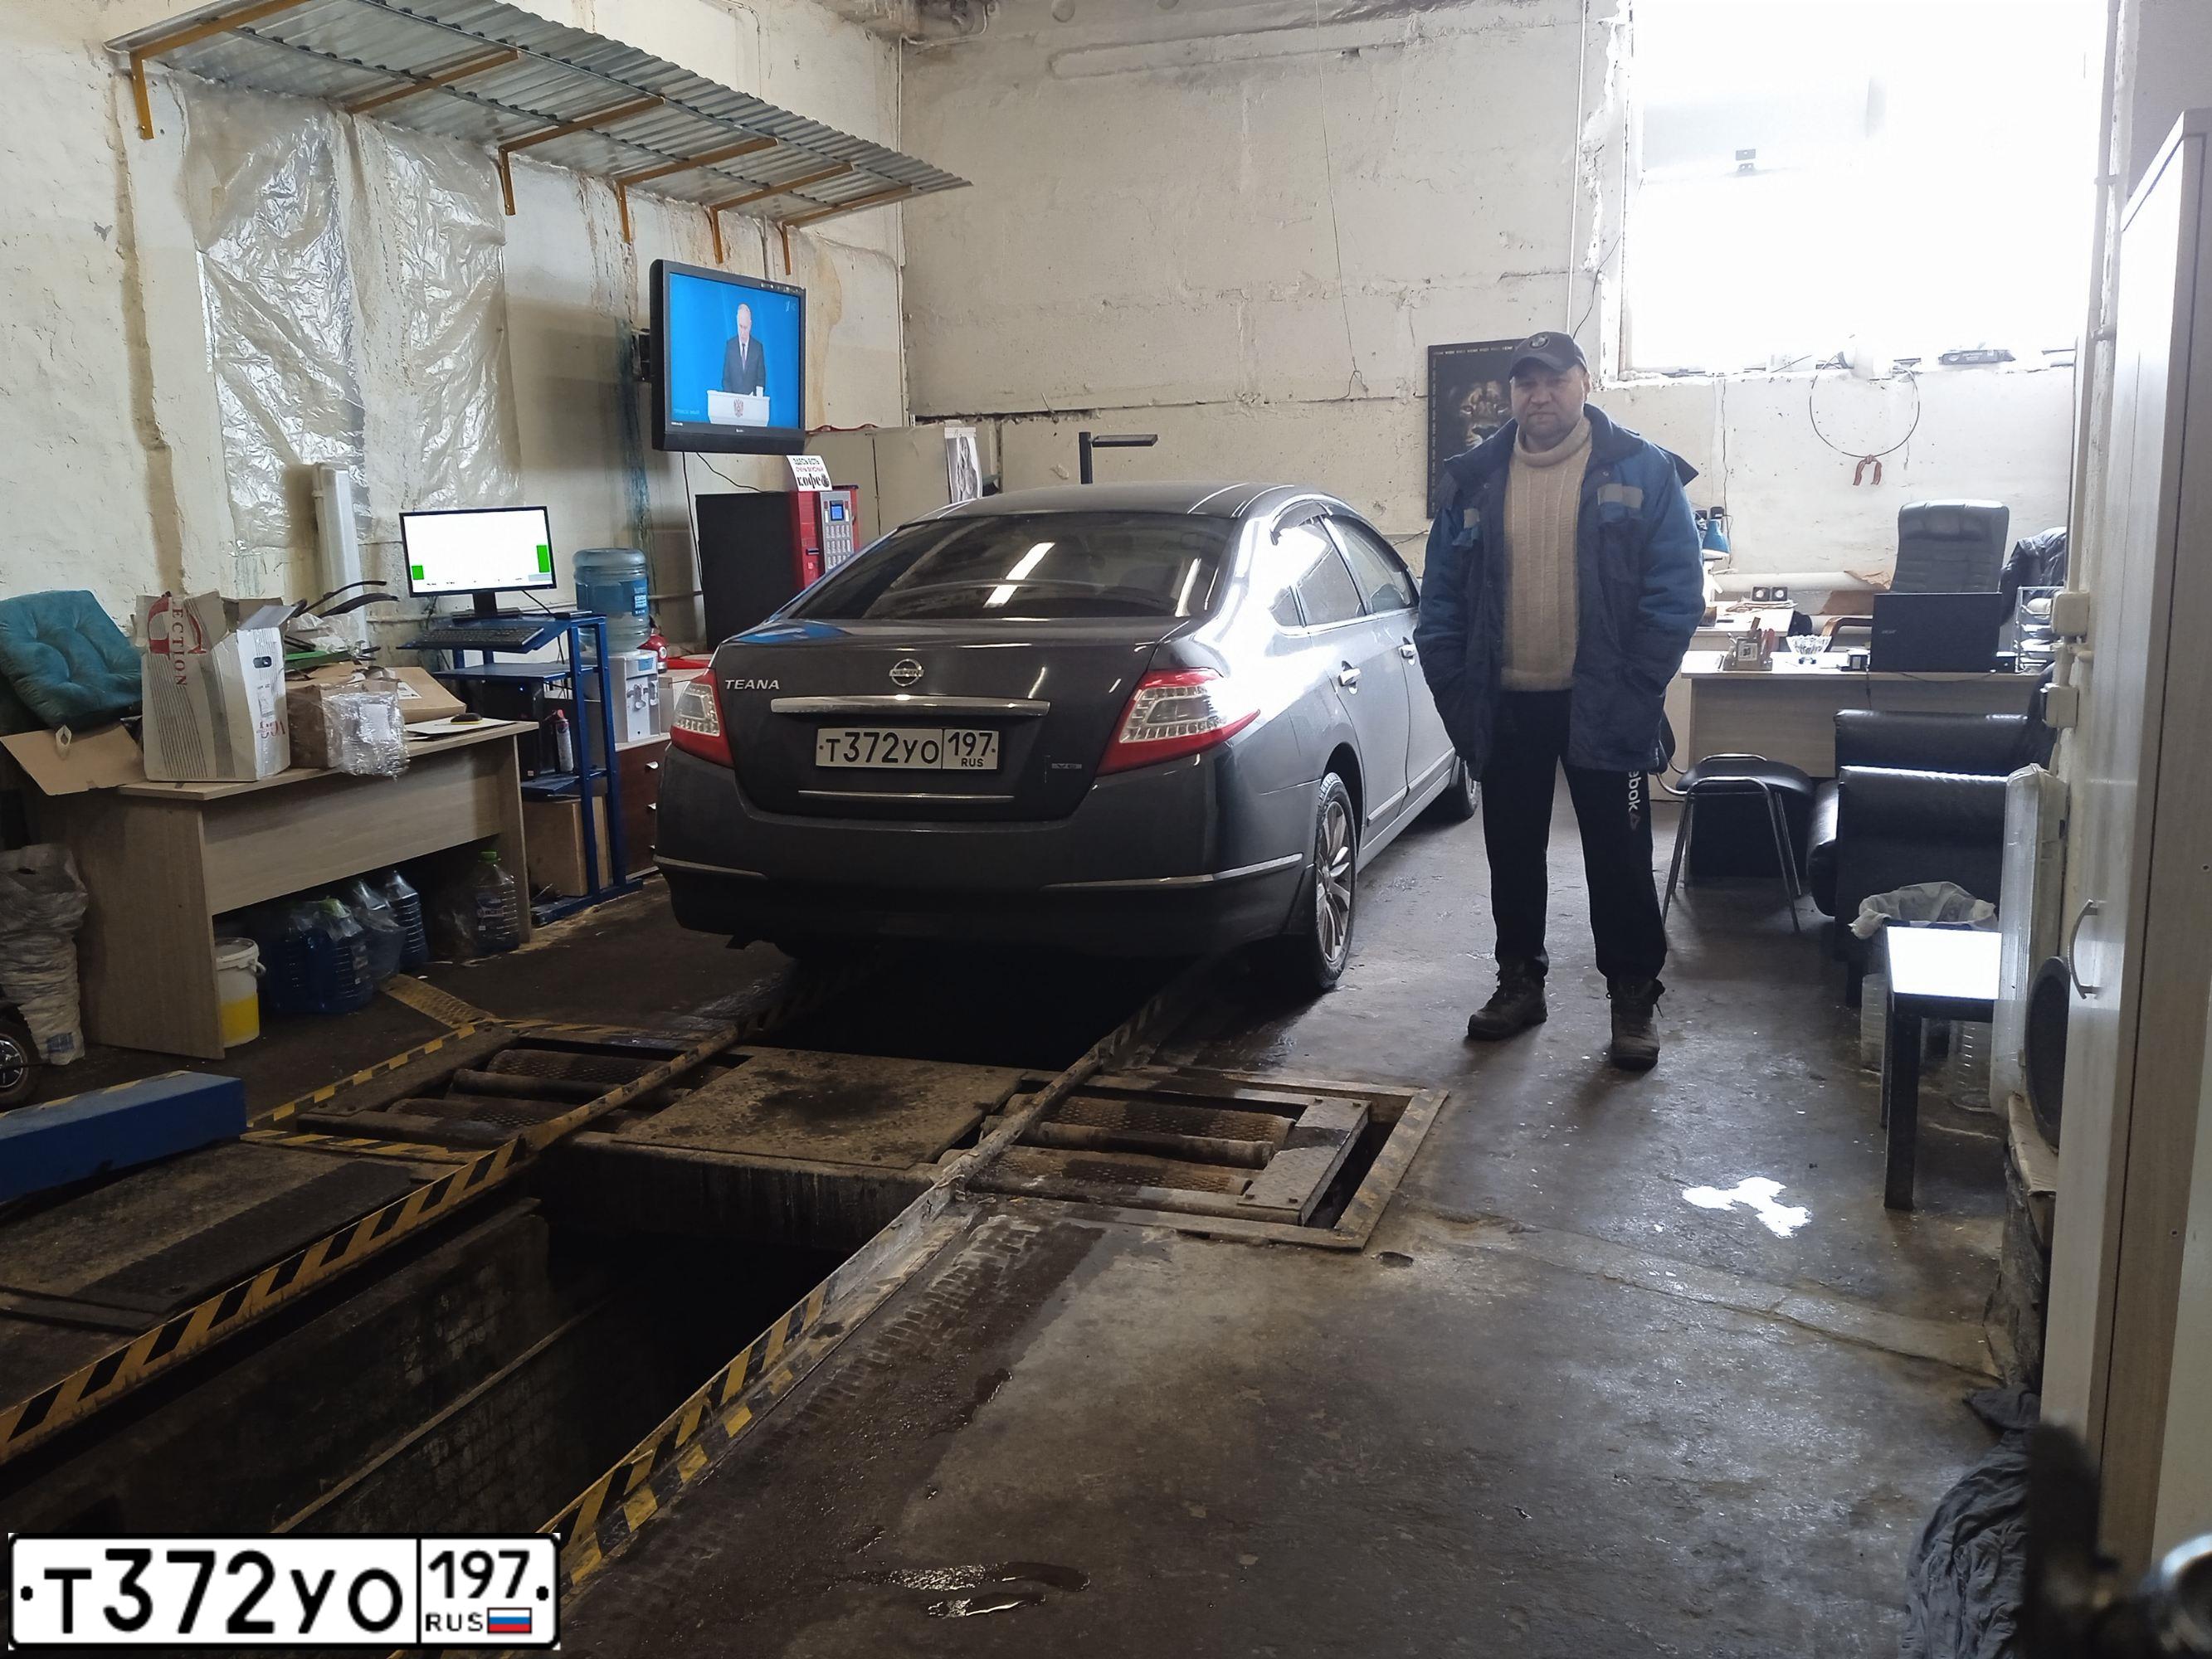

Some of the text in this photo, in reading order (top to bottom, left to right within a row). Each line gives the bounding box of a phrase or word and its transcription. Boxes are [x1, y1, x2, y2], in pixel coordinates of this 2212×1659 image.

[797, 473, 821, 489] кофе
[171, 597, 188, 687] ECTION
[724, 679, 780, 689] TEANA
[948, 732, 993, 757] 197
[961, 757, 984, 767] RUS
[1628, 770, 1641, 812] ebok
